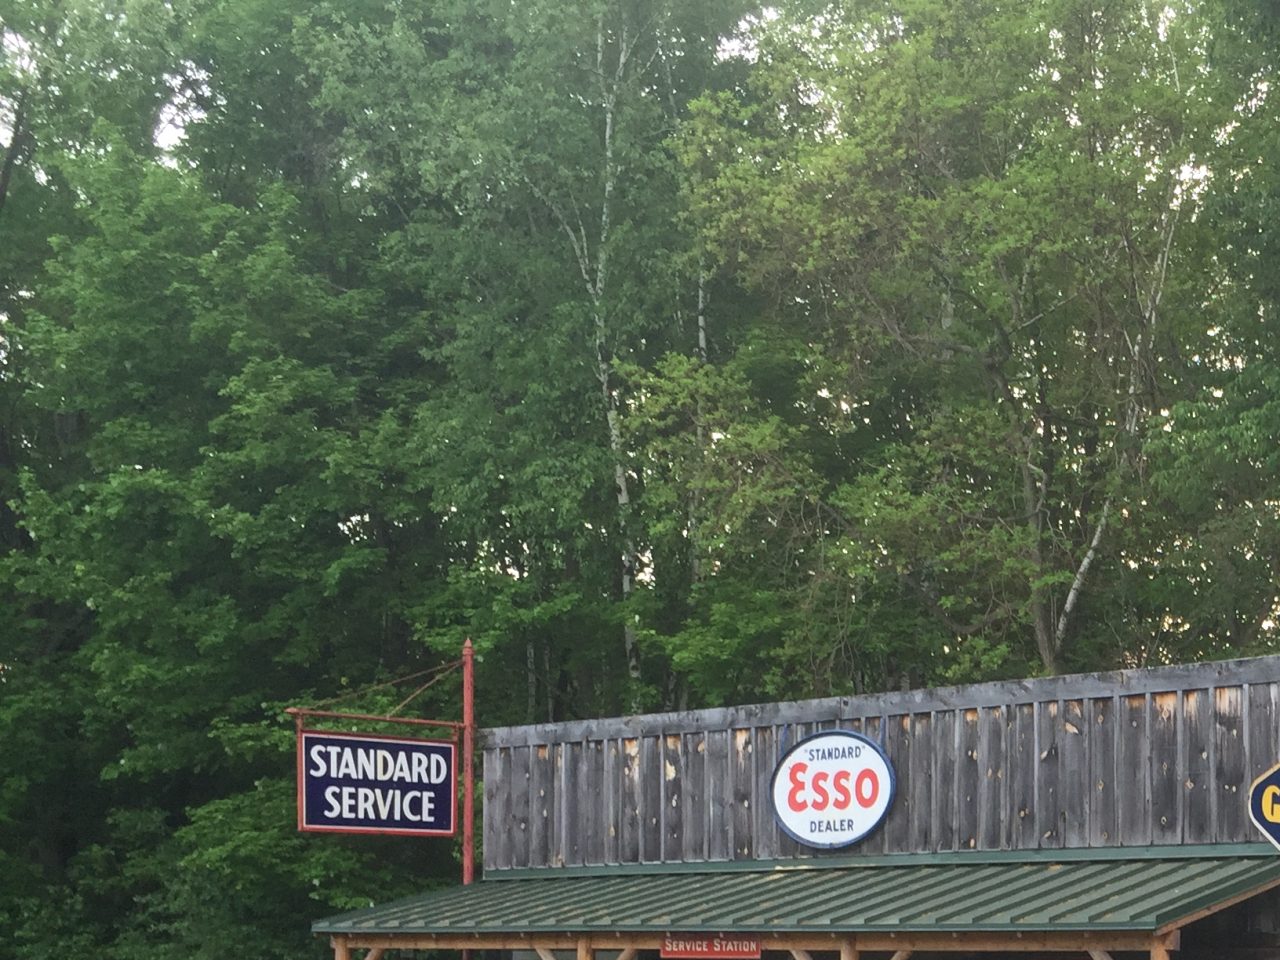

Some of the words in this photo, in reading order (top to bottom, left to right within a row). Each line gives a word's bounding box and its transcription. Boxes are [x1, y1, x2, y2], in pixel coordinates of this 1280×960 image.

[309, 744, 447, 784] STANDARD
[323, 785, 435, 822] SERVICE
[810, 819, 854, 833] DEALER
[665, 938, 708, 952] SERVICE
[713, 938, 757, 952] STATION
